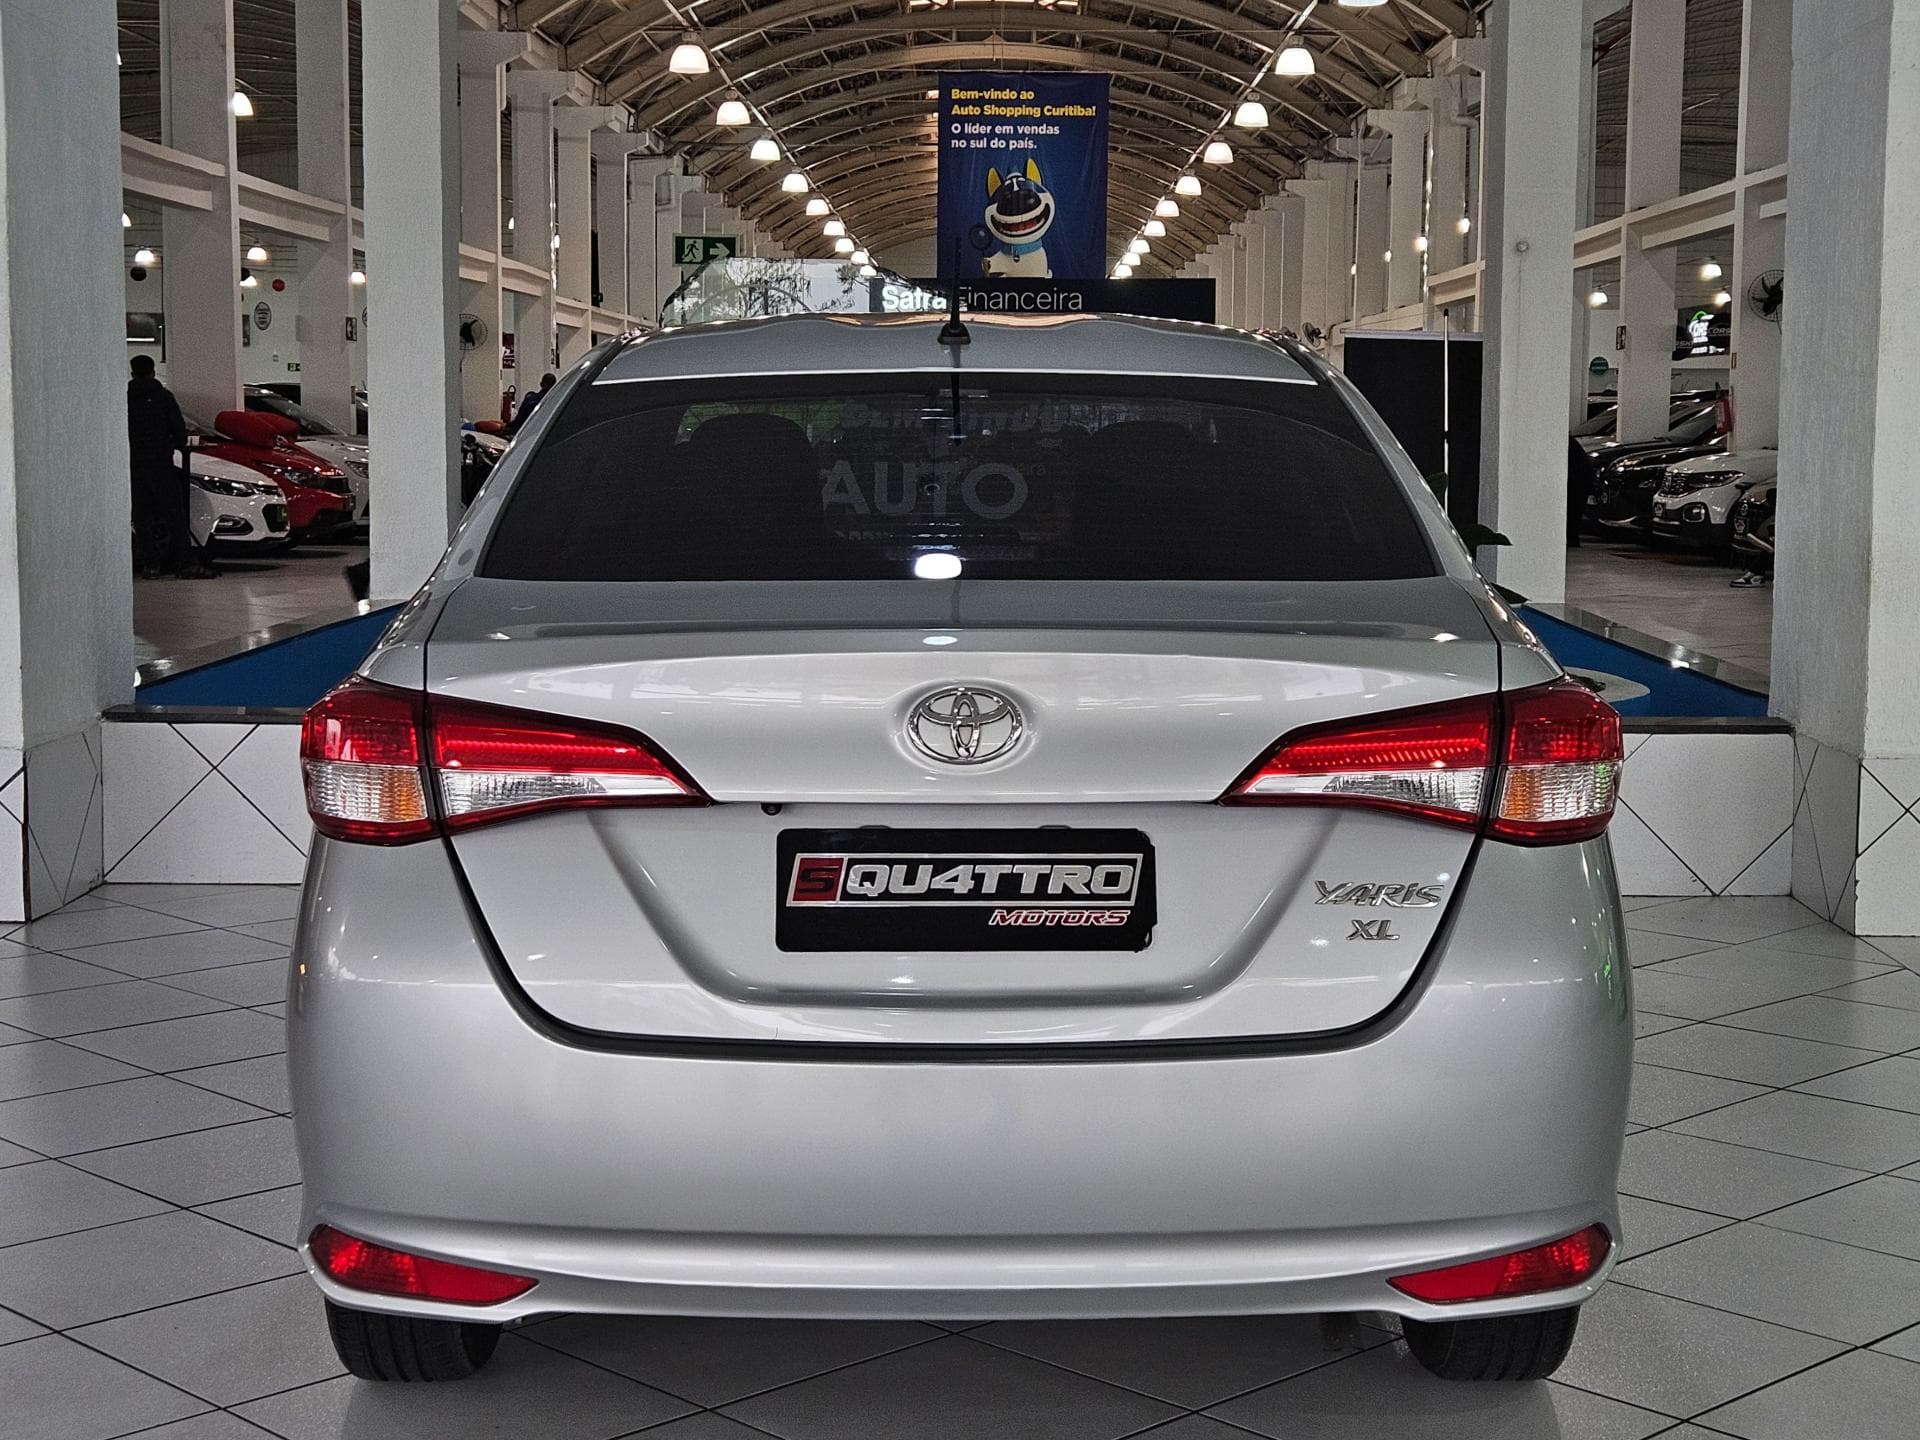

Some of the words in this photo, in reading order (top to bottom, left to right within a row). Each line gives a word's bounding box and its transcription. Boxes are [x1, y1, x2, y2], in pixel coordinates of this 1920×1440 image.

[951, 88, 1017, 100] Bem-vindo
[1019, 90, 1035, 100] ao
[951, 105, 981, 116] Auto
[983, 105, 1041, 118] Shopping
[1043, 105, 1096, 116] Curitiba!
[951, 123, 961, 134] O
[964, 122, 992, 134] líder
[994, 125, 1014, 134] em
[1016, 124, 1060, 135] vendas
[951, 139, 967, 148] no
[970, 137, 987, 148] sul
[990, 137, 1006, 148] do
[1009, 137, 1038, 150] país.
[882, 284, 947, 310] Safra
[1314, 880, 1444, 908] YARIS
[988, 909, 1131, 926] MOTORS
[1346, 919, 1400, 940] XL
